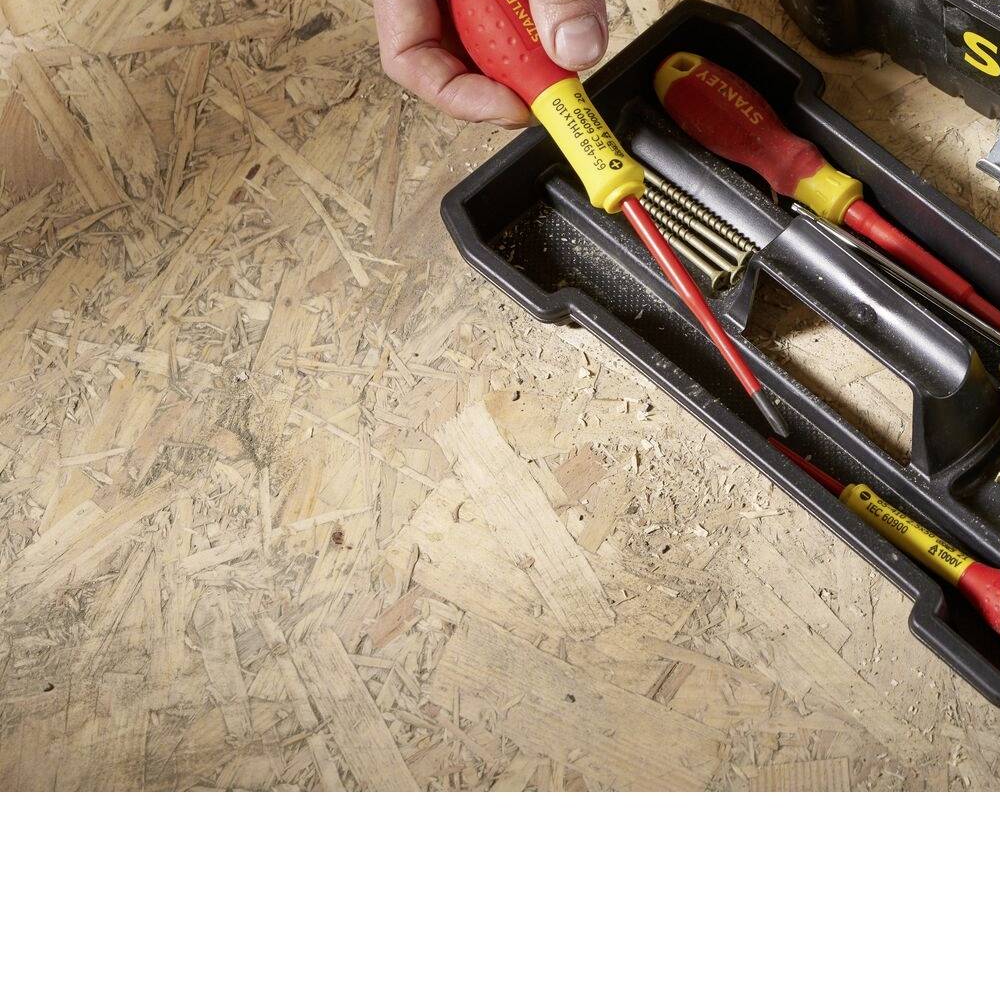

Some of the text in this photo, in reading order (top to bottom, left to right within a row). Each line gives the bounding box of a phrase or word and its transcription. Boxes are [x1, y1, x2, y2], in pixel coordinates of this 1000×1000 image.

[696, 70, 764, 125] STANLEY
[573, 108, 607, 151] IEC 60900
[584, 107, 603, 130] 1000V
[579, 138, 607, 171] 65-498
[866, 502, 909, 535] IEC 60900
[938, 549, 962, 568] 1000V
